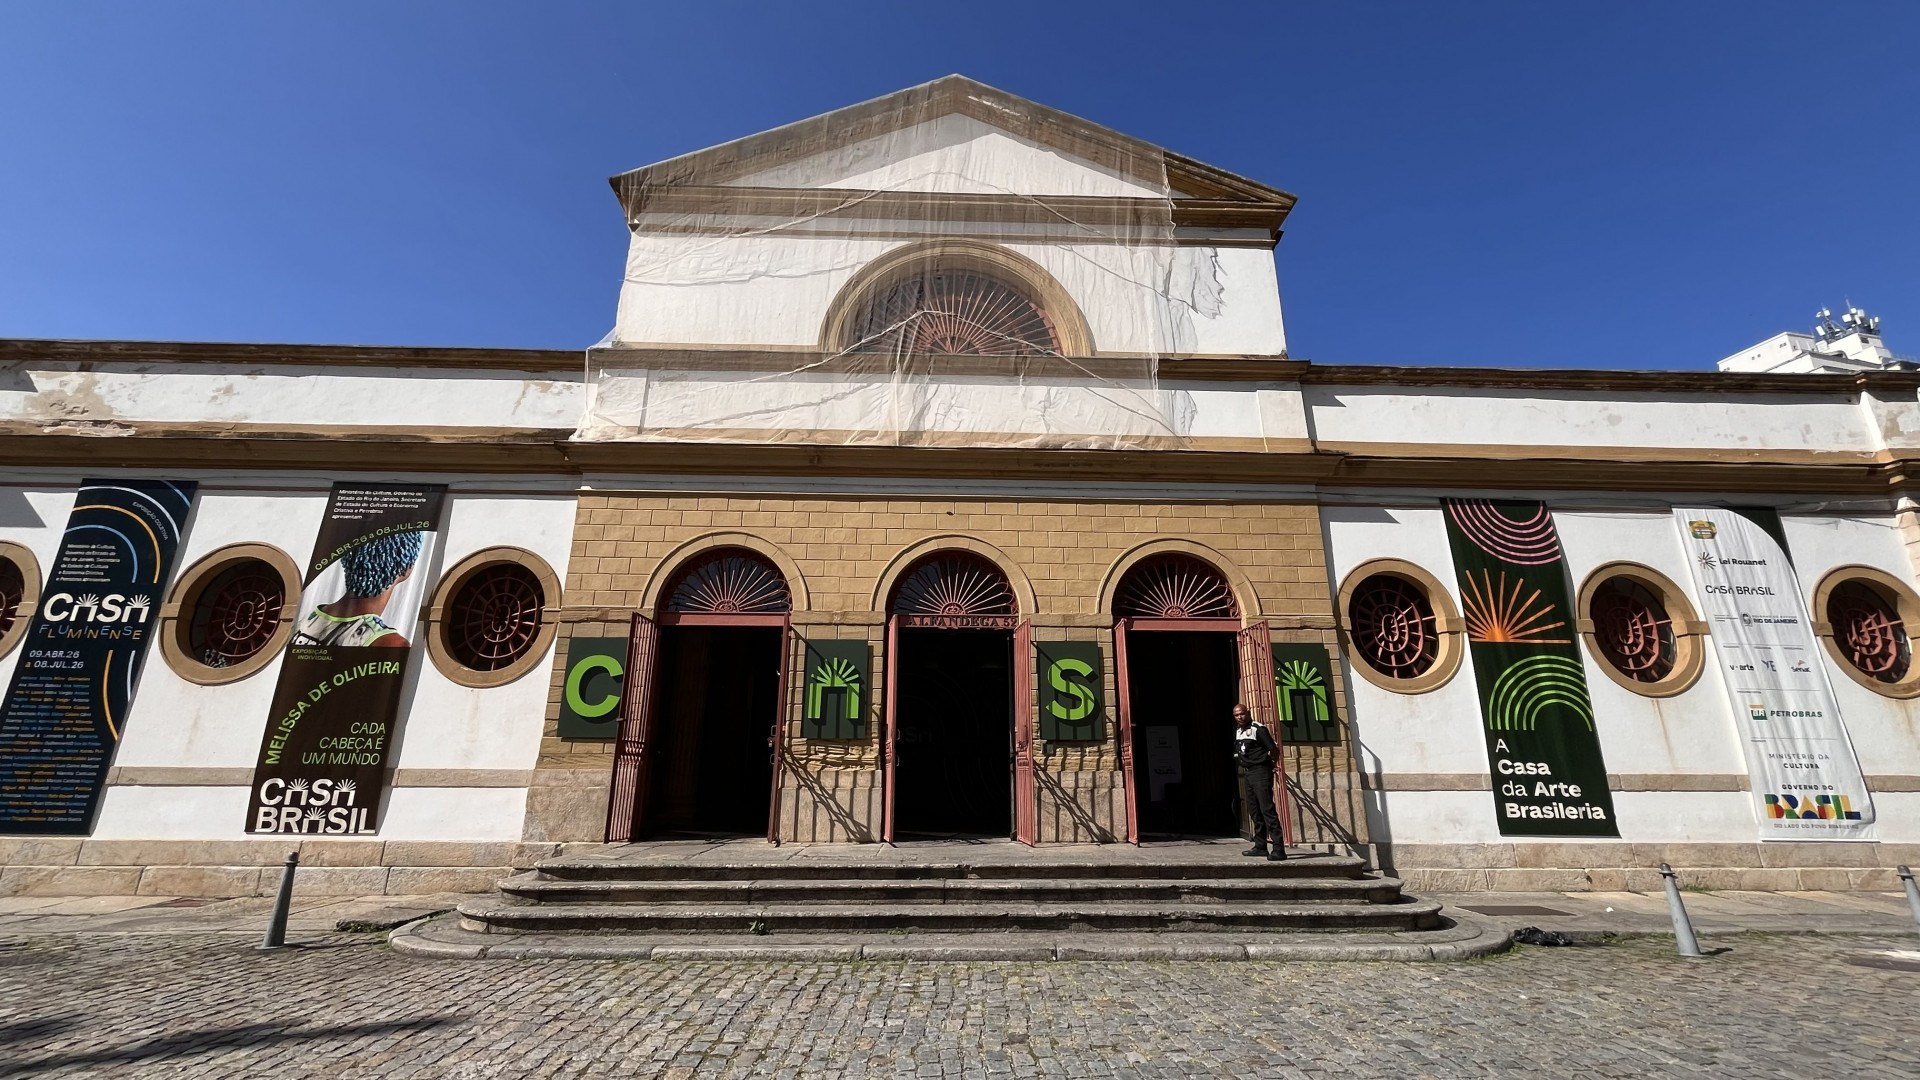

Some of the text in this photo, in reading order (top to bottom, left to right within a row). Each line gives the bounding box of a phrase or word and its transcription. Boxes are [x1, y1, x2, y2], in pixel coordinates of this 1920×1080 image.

[315, 536, 367, 571] 09.ABR.26
[376, 521, 430, 536] 08.JUL.26
[39, 624, 142, 640] FLUMINENSE
[266, 661, 400, 764] MELISSA DE OLIVEIRA
[350, 722, 386, 734] CADA
[319, 735, 384, 753] CABEÇA É
[1495, 738, 1510, 753] A
[302, 752, 380, 765] UM MUNDO
[1497, 759, 1551, 775] Casa
[1502, 780, 1582, 798] da Arte
[1505, 802, 1606, 820] Brasileria
[1764, 794, 1861, 820] BRASIL
